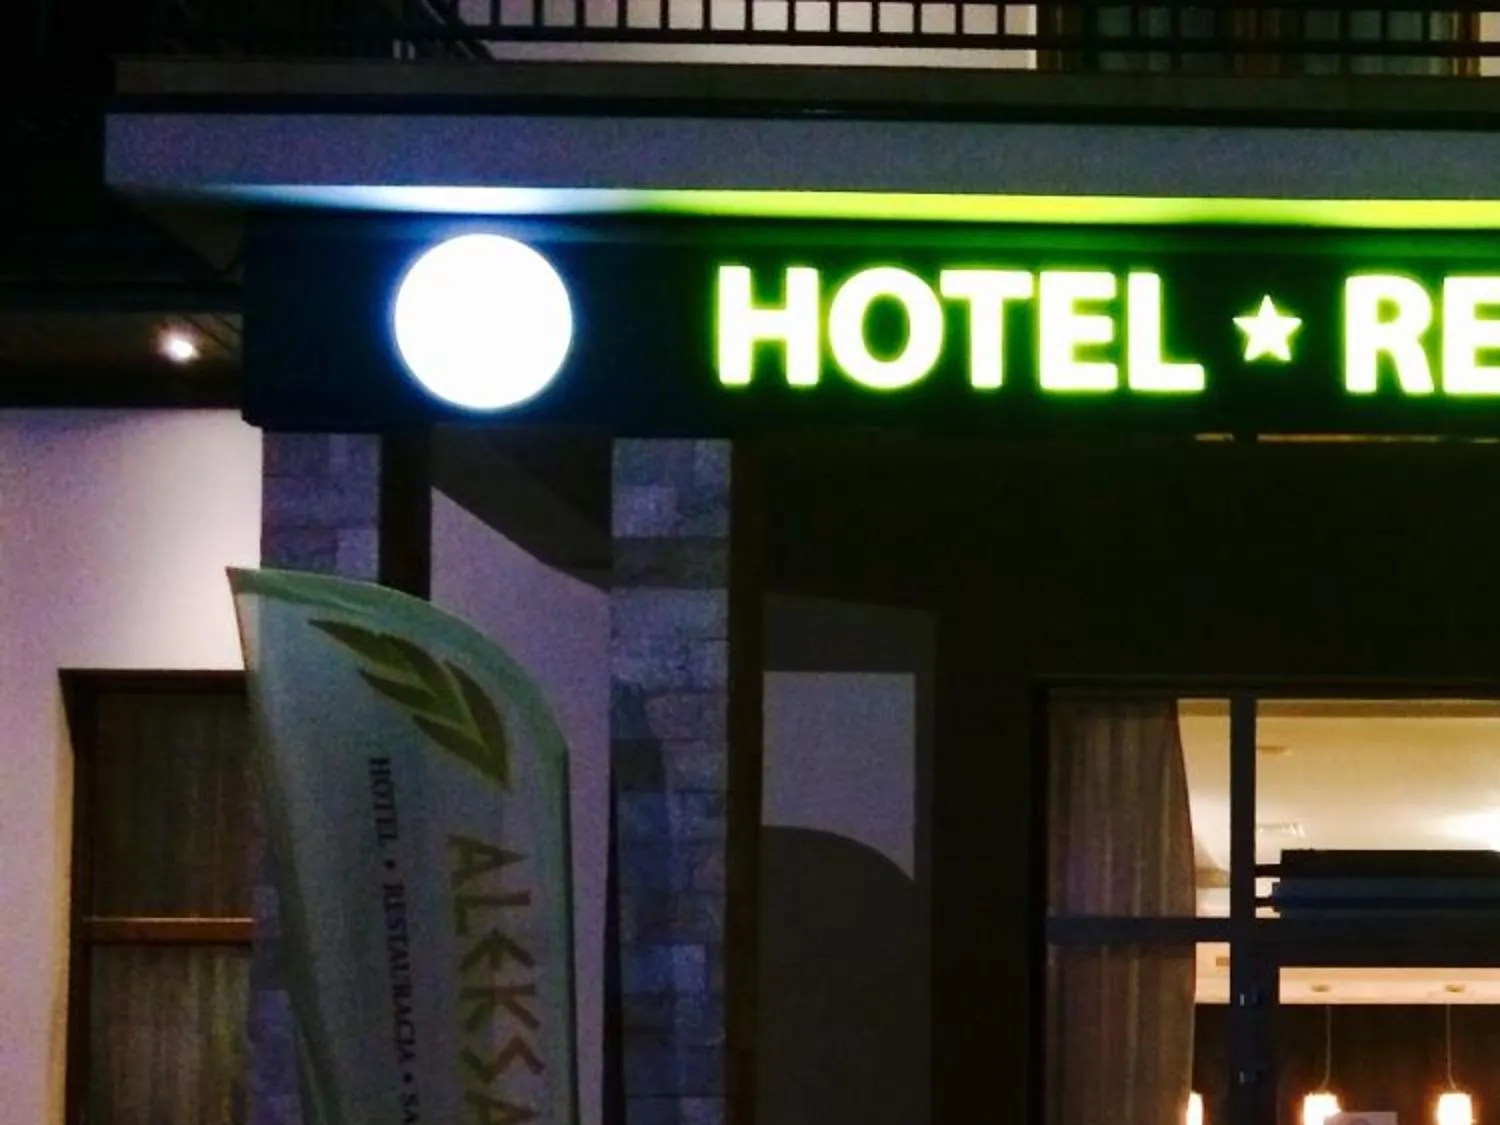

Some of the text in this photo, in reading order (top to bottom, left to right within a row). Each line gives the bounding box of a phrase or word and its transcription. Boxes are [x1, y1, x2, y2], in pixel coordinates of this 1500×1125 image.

[715, 263, 1206, 393] HOTEL
[368, 757, 399, 846] HOTEL
[383, 882, 417, 1066] RESTAURACJA
